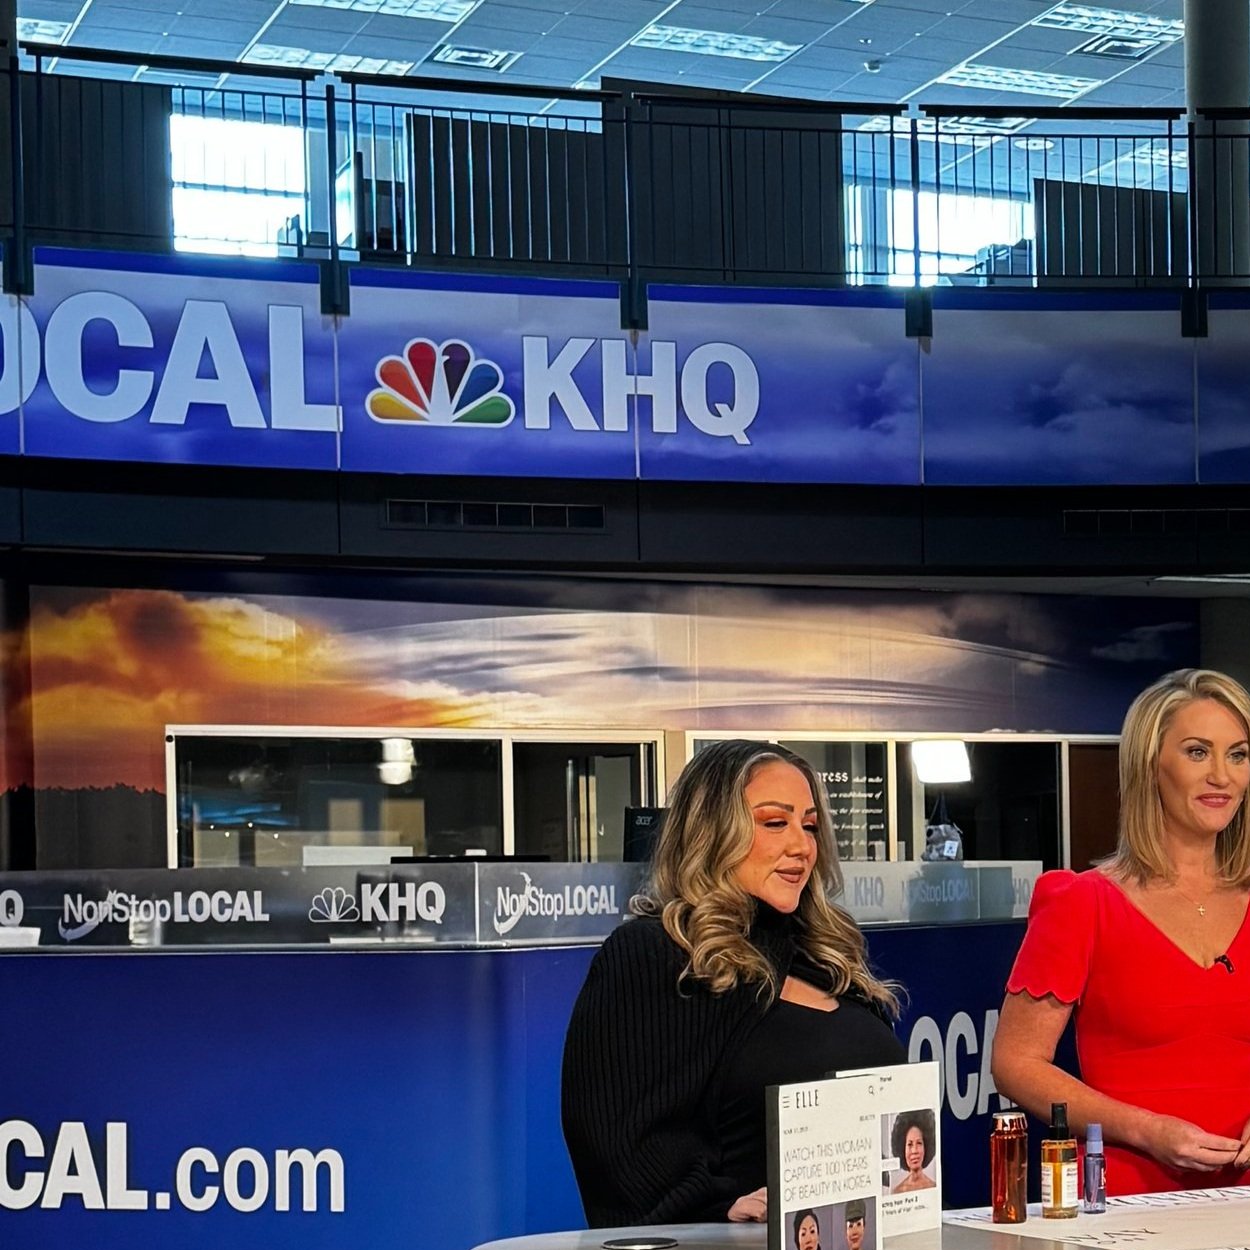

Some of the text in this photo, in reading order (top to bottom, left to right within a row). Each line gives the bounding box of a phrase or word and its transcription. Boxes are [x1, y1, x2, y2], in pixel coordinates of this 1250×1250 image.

[521, 335, 761, 446] KHQ
[360, 881, 446, 925] KHQ
[795, 1088, 820, 1110] ELLE
[783, 1137, 872, 1163] WATCH THIS WOMAN
[0, 1119, 345, 1213] CAL.com
[783, 1163, 823, 1183] CAPTURE
[825, 1160, 841, 1176] 100
[842, 1156, 869, 1173] YEARS
[783, 1174, 873, 1203] OF BEAUTY IN KOREA
